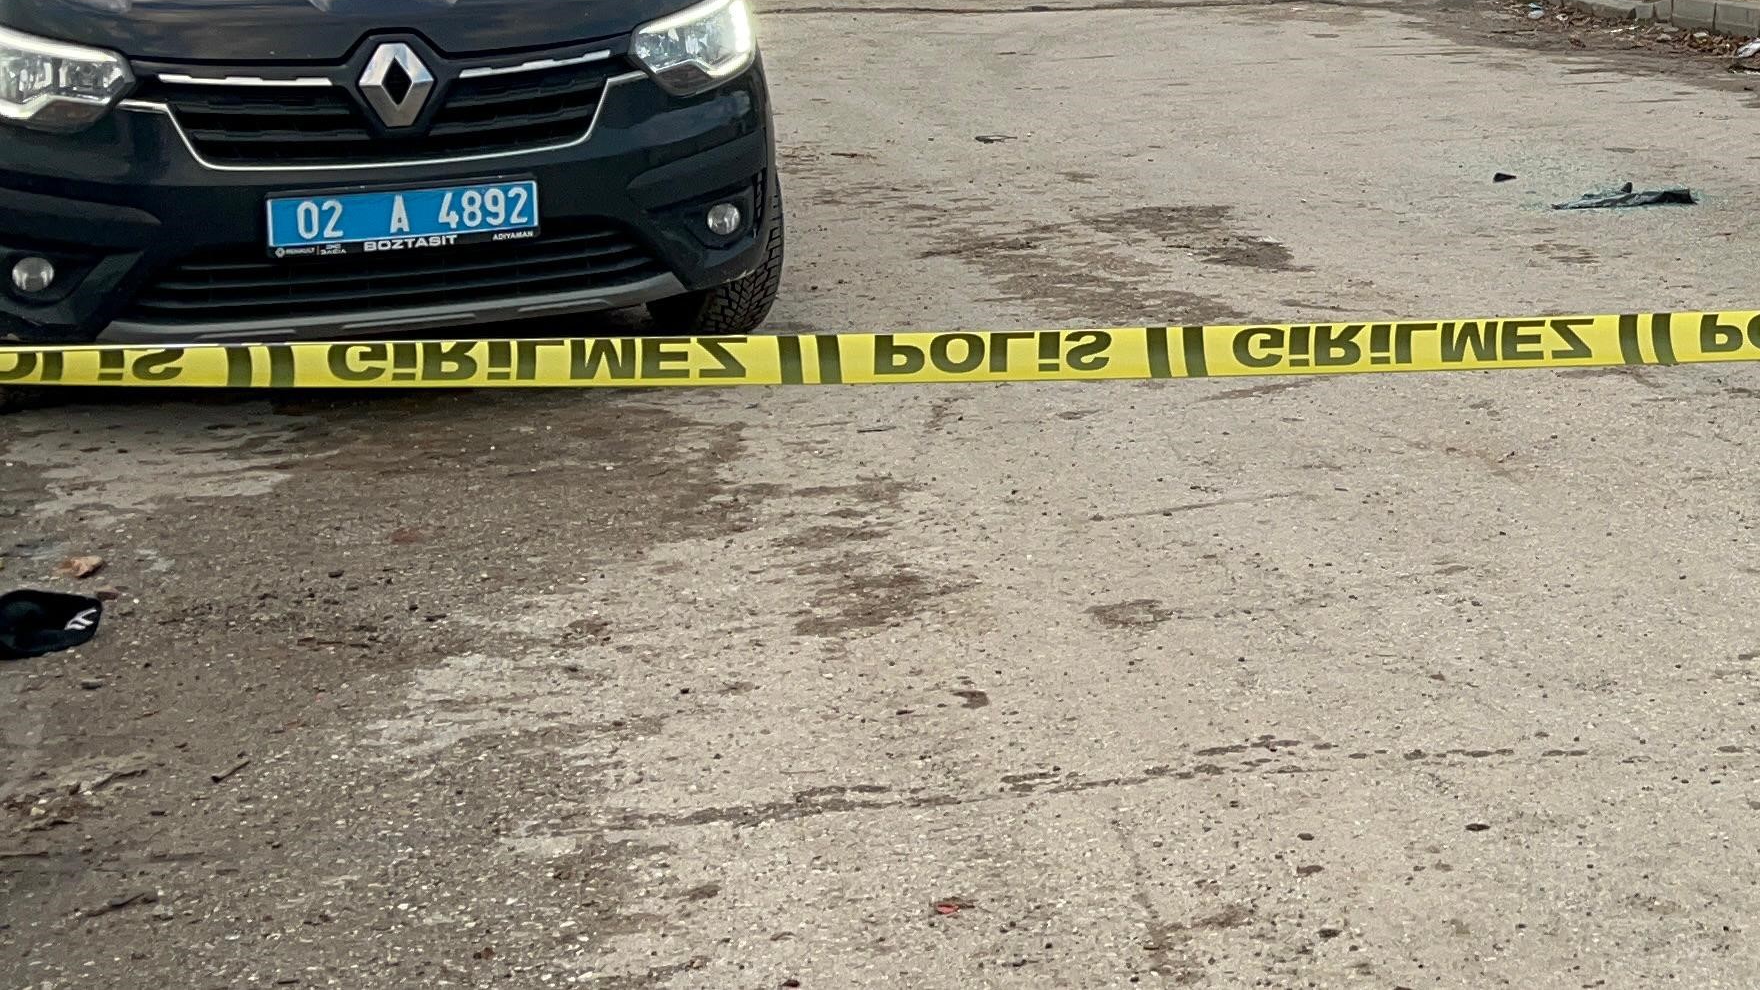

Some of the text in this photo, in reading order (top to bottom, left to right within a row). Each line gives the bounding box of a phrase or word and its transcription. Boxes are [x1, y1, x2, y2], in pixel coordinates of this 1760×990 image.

[297, 186, 529, 240] 02 A 4892
